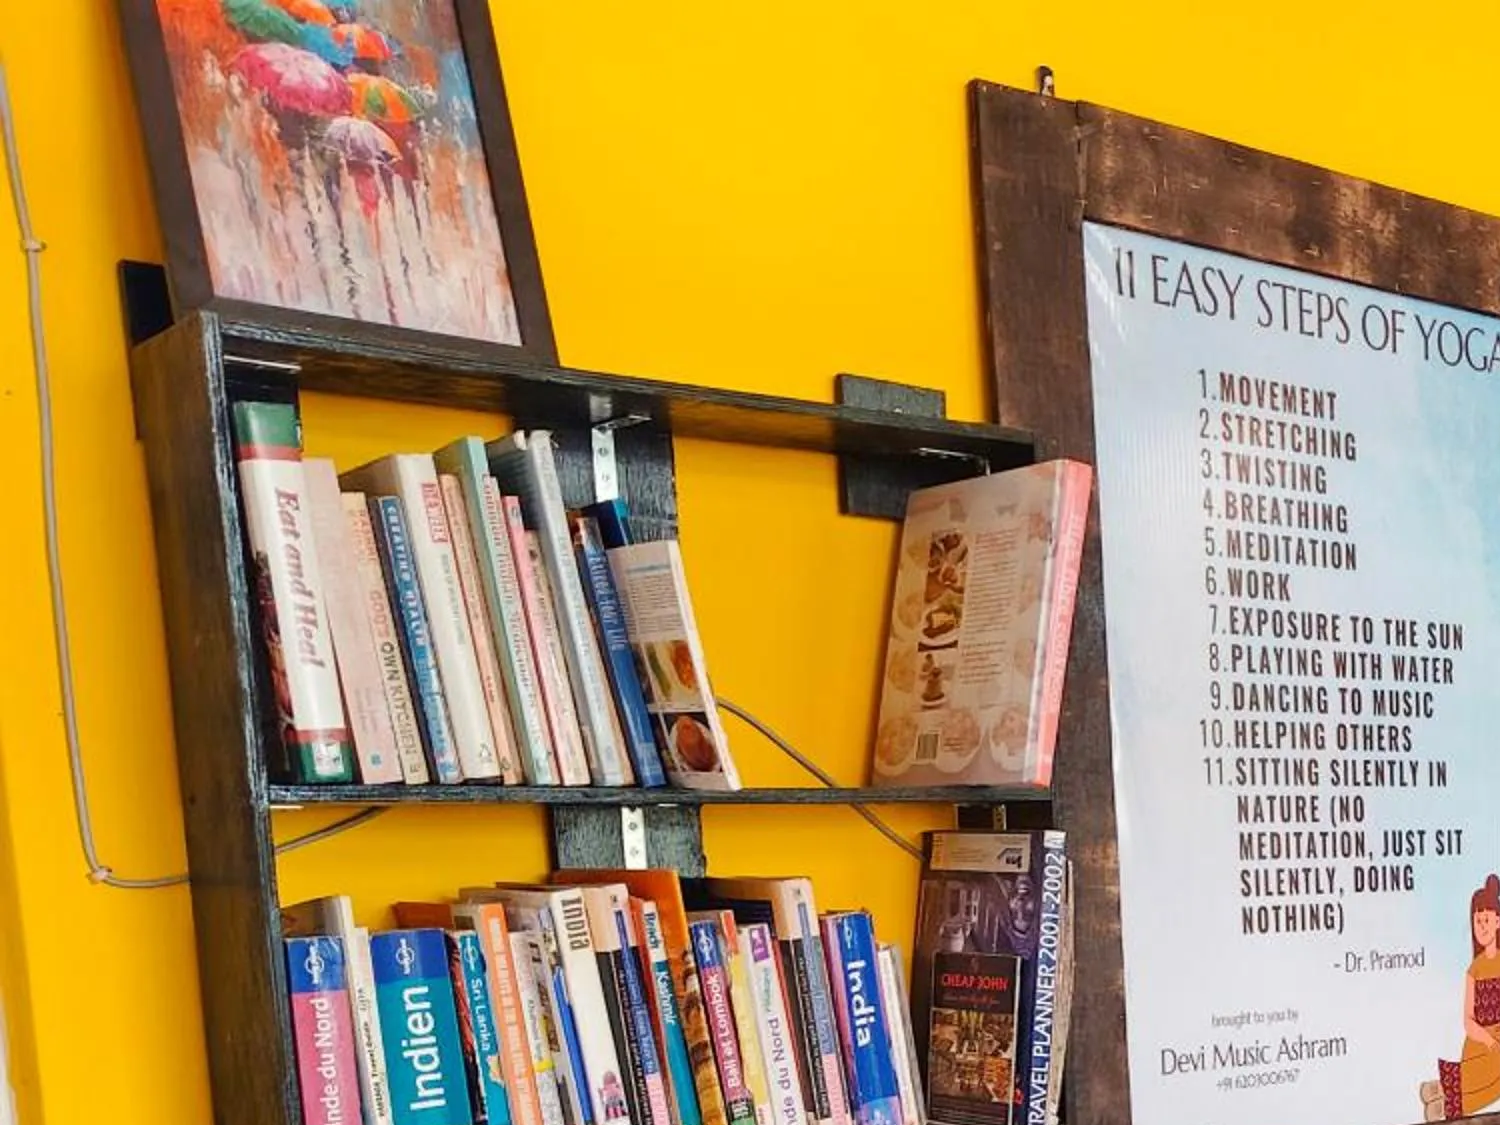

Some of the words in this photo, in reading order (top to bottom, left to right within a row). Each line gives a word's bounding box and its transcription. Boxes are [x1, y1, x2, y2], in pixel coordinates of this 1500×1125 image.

[1114, 247, 1136, 299] 11
[1152, 256, 1242, 320] EASY
[1256, 279, 1350, 344] STEPS
[1361, 303, 1406, 353] OF
[275, 487, 299, 541] Eat
[287, 546, 314, 600] and
[386, 504, 411, 582] CREATING
[400, 590, 426, 647] HEALTH
[294, 597, 326, 669] Heal
[1349, 615, 1374, 645] TO
[1383, 617, 1419, 648] THE
[1427, 621, 1464, 652] SUN
[380, 640, 400, 682] OWN
[1332, 650, 1383, 682] WITH
[1391, 653, 1455, 685] WATER
[389, 683, 417, 755] KITCHEN
[1338, 687, 1363, 716] TO
[1372, 689, 1434, 719] MUSIC
[1336, 722, 1414, 752] OTHERS
[1329, 759, 1419, 788] SILENTLY
[1428, 760, 1448, 788] IN
[1237, 795, 1320, 825] NATURE
[1329, 794, 1366, 825] (NO
[1239, 830, 1374, 862] MEDITATION,
[1381, 830, 1426, 857] JUST
[1435, 829, 1464, 856] SIT
[1240, 867, 1345, 899] SILENTLY,
[1354, 864, 1415, 893] DOING
[1040, 853, 1065, 958] 2001-2002
[1241, 901, 1345, 936] NOTHING)
[1344, 950, 1368, 974] Dr.
[1370, 946, 1425, 971] Pramod
[471, 978, 484, 1000] Sri
[656, 971, 676, 1026] Kashmir
[708, 973, 730, 1036] Lombok
[847, 959, 876, 1048] India
[1032, 959, 1057, 1053] PLANNER
[310, 997, 333, 1048] Nord
[474, 1005, 491, 1052] Lanka
[1211, 1011, 1250, 1029] brought
[1254, 1011, 1265, 1023] to
[1267, 1012, 1285, 1026] you
[1287, 1008, 1299, 1024] by
[401, 986, 447, 1110] Indien
[768, 1018, 787, 1064] Nord
[1160, 1045, 1206, 1076] Devi
[1212, 1039, 1271, 1070] Music
[1276, 1033, 1347, 1063] Ashram
[317, 1052, 337, 1079] du
[723, 1057, 740, 1089] Bali
[777, 1067, 791, 1090] du
